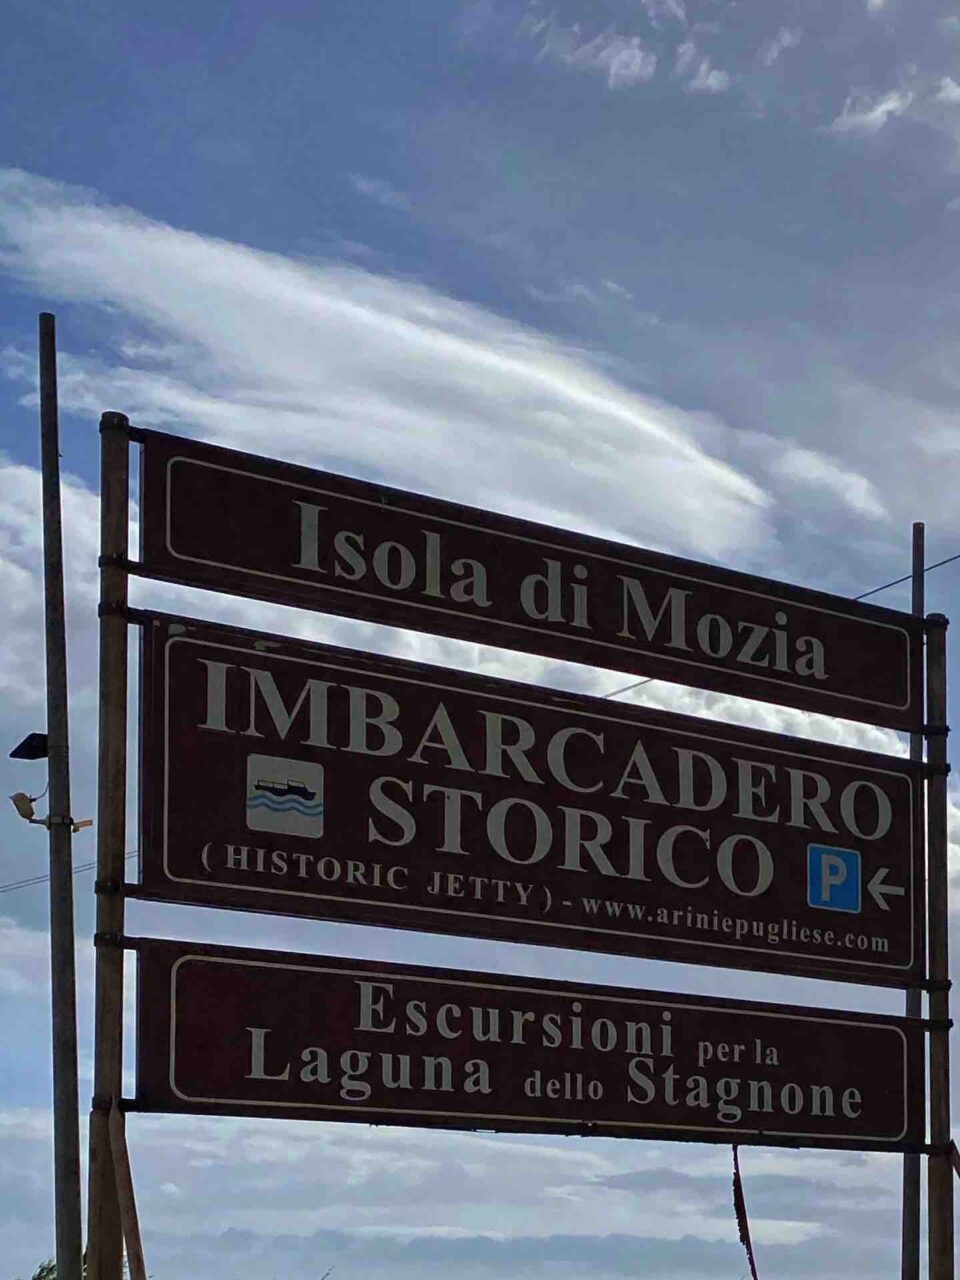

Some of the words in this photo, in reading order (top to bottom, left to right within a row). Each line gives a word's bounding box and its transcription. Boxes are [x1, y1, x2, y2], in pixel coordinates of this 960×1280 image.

[291, 500, 493, 607] Isola
[520, 557, 593, 630] di
[617, 575, 829, 680] Mozia
[197, 658, 893, 841] IMBARCADERO
[368, 776, 774, 896] STORICO
[820, 854, 848, 902] P
[582, 898, 890, 953] www.ariniepugliese.com
[354, 981, 675, 1057] Escursioni
[698, 1039, 745, 1068] per
[755, 1038, 779, 1066] la
[244, 1027, 492, 1101] Laguna
[524, 1070, 604, 1100] dello
[627, 1057, 863, 1123] Stagnone
